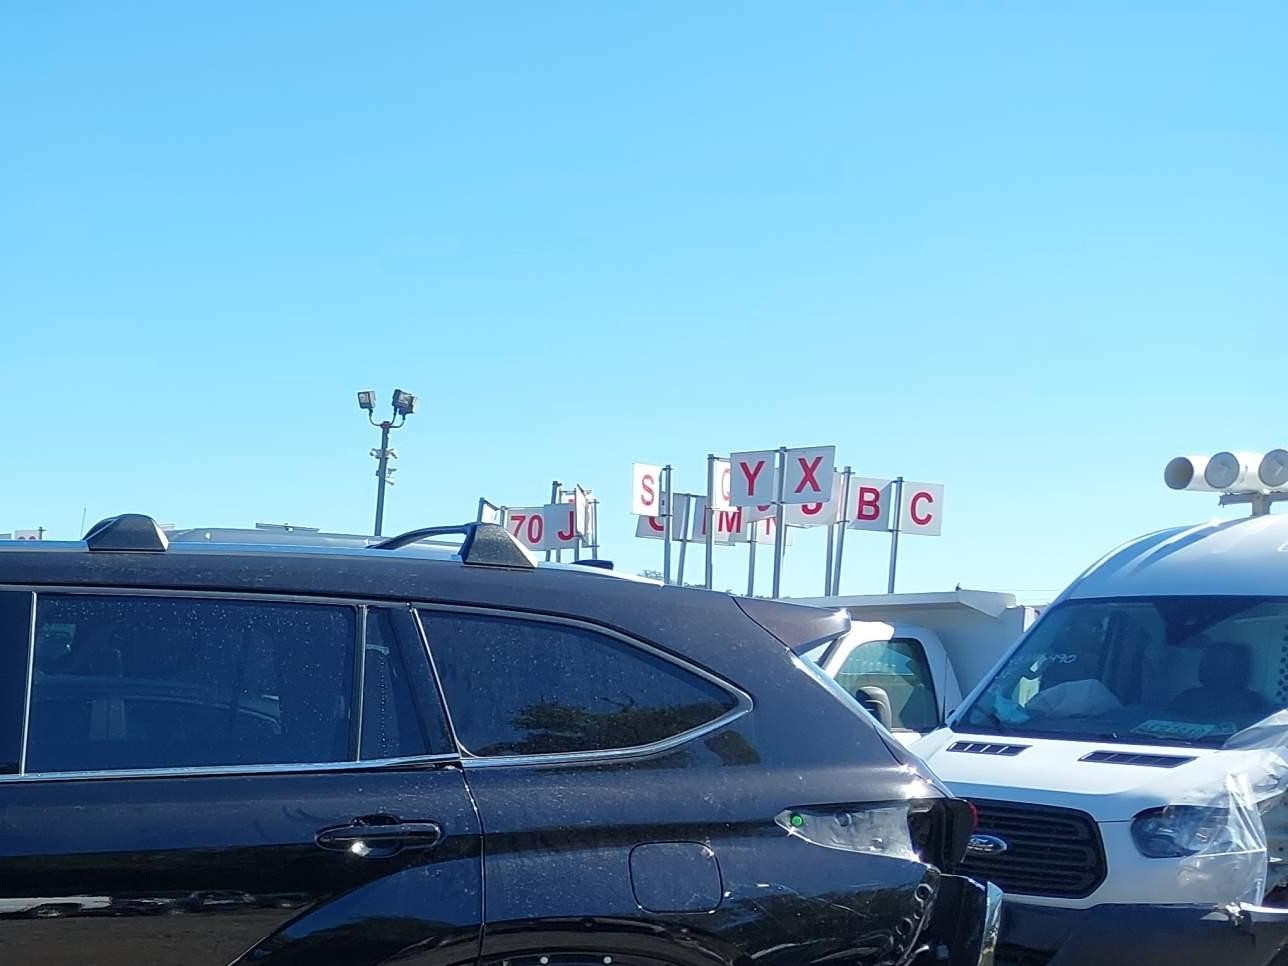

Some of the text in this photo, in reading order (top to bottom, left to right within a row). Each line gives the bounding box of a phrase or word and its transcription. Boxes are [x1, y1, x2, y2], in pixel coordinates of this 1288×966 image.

[640, 474, 655, 506] S
[739, 460, 766, 496] Y
[794, 456, 824, 494] X
[856, 486, 881, 521] B
[910, 491, 934, 526] C
[510, 514, 544, 544] 70
[557, 511, 575, 541] J
